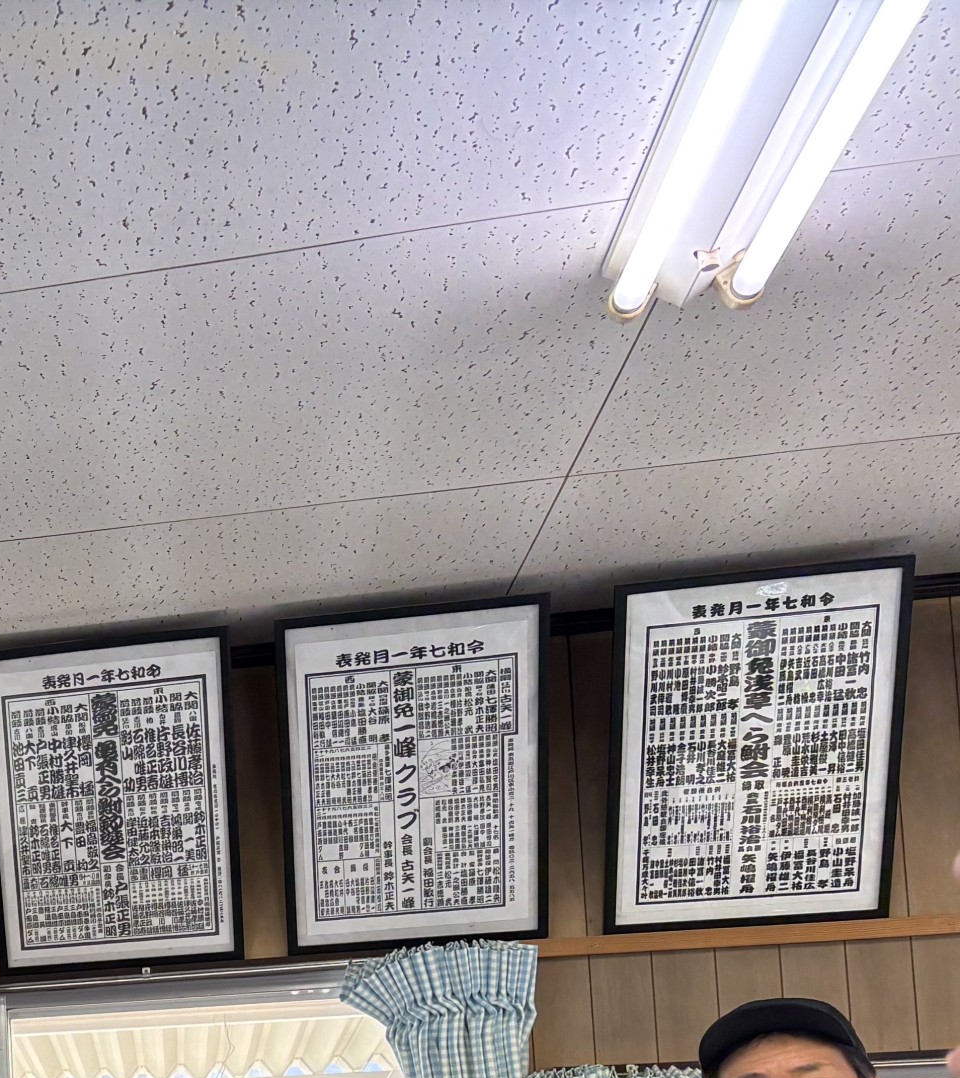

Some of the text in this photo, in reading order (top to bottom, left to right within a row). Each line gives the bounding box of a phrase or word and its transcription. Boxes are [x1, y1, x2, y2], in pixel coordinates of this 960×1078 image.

[692, 592, 835, 619] 令和七年一月発表
[336, 639, 485, 668] 令和七年一月発表
[42, 664, 161, 689] 令和七年一月発表
[401, 834, 413, 856] 会長
[384, 871, 395, 911] 鈴木正夫
